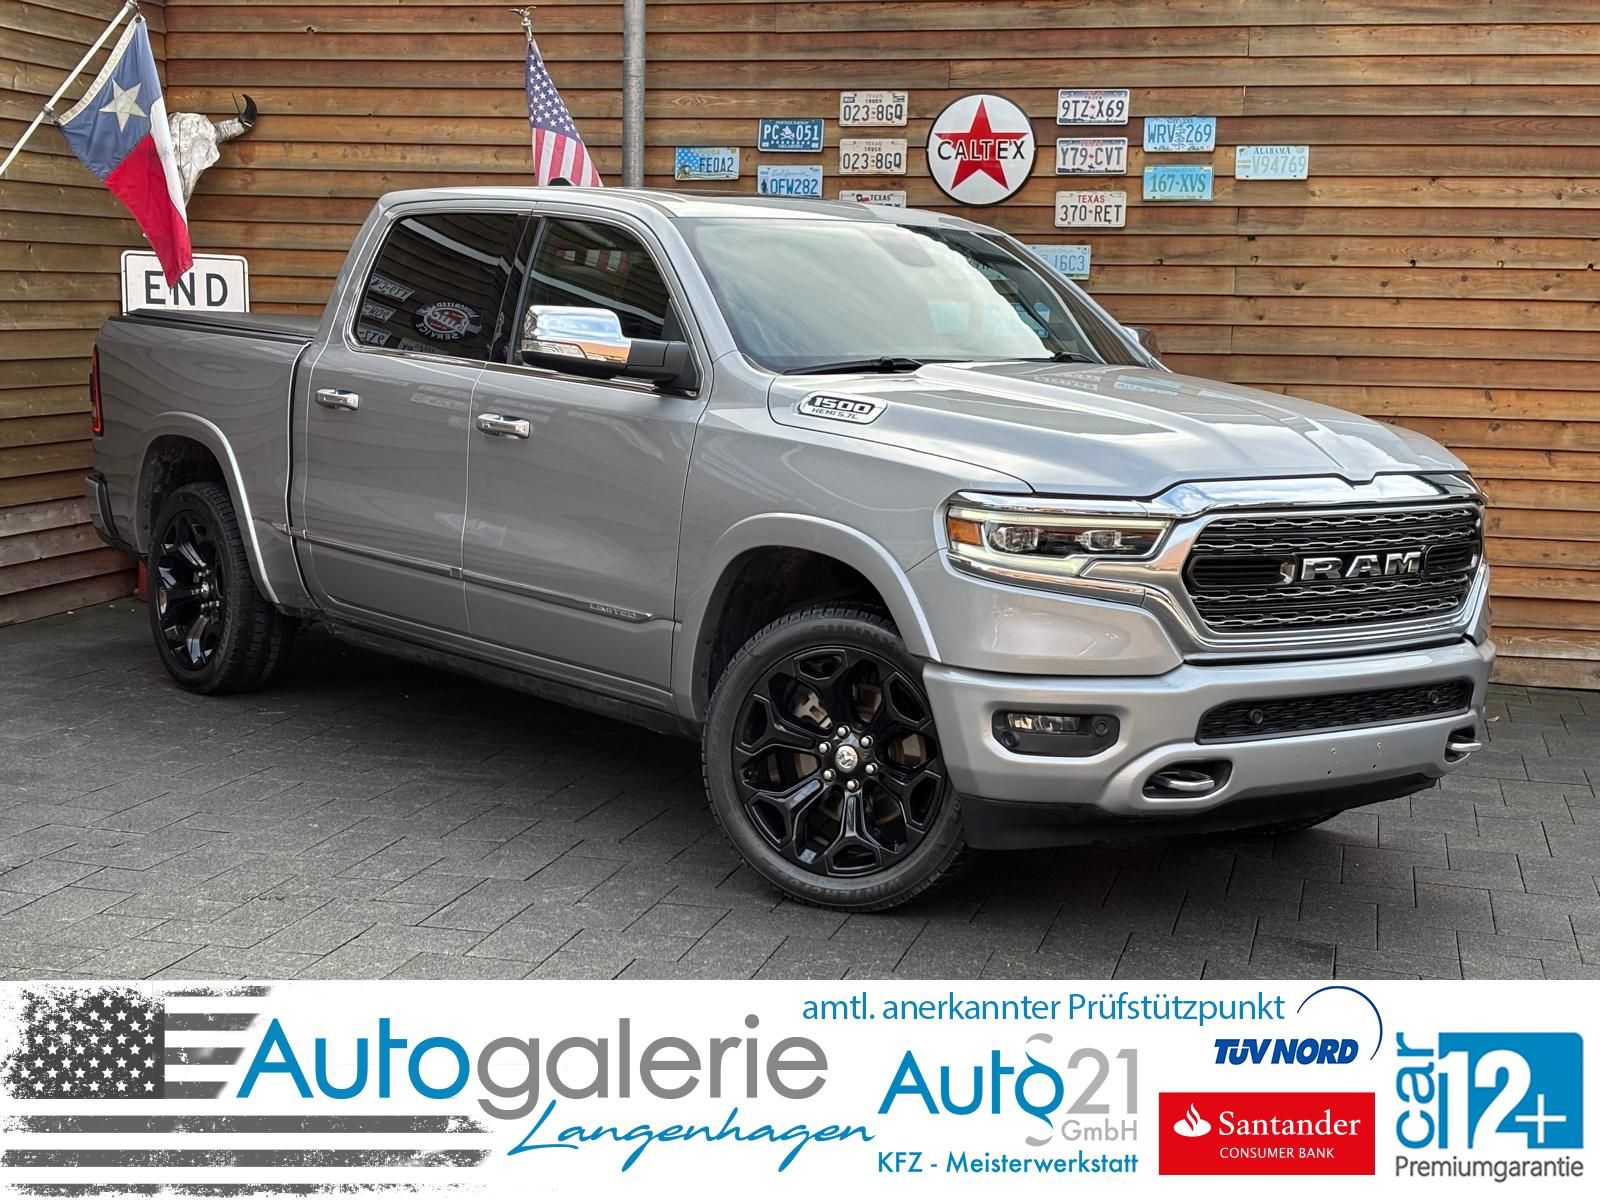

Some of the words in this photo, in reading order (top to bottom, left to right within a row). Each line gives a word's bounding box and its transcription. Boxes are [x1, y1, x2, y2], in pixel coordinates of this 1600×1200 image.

[843, 104, 870, 121] 023
[876, 103, 903, 121] 8GQ
[1062, 100, 1090, 118] 9TZ
[1097, 100, 1125, 118] X69
[763, 124, 779, 140] PC
[796, 124, 820, 141] 051
[1147, 124, 1176, 144] WRV
[1185, 123, 1212, 143] 269
[937, 140, 1026, 161] CALTEX
[1060, 147, 1088, 166] Y79
[1095, 147, 1123, 166] CVT
[1253, 147, 1291, 155] ALABAMA
[842, 153, 869, 170] 023
[875, 152, 902, 169] 8GQ
[1252, 155, 1306, 174] V94769
[1077, 195, 1105, 203] TEXAS
[1060, 205, 1087, 222] 370
[1094, 205, 1122, 222] RET
[144, 270, 228, 307] END
[811, 407, 837, 416] HEMI
[814, 396, 872, 414] 1500
[1301, 552, 1421, 581] RAM
[589, 602, 637, 619] LIMITED
